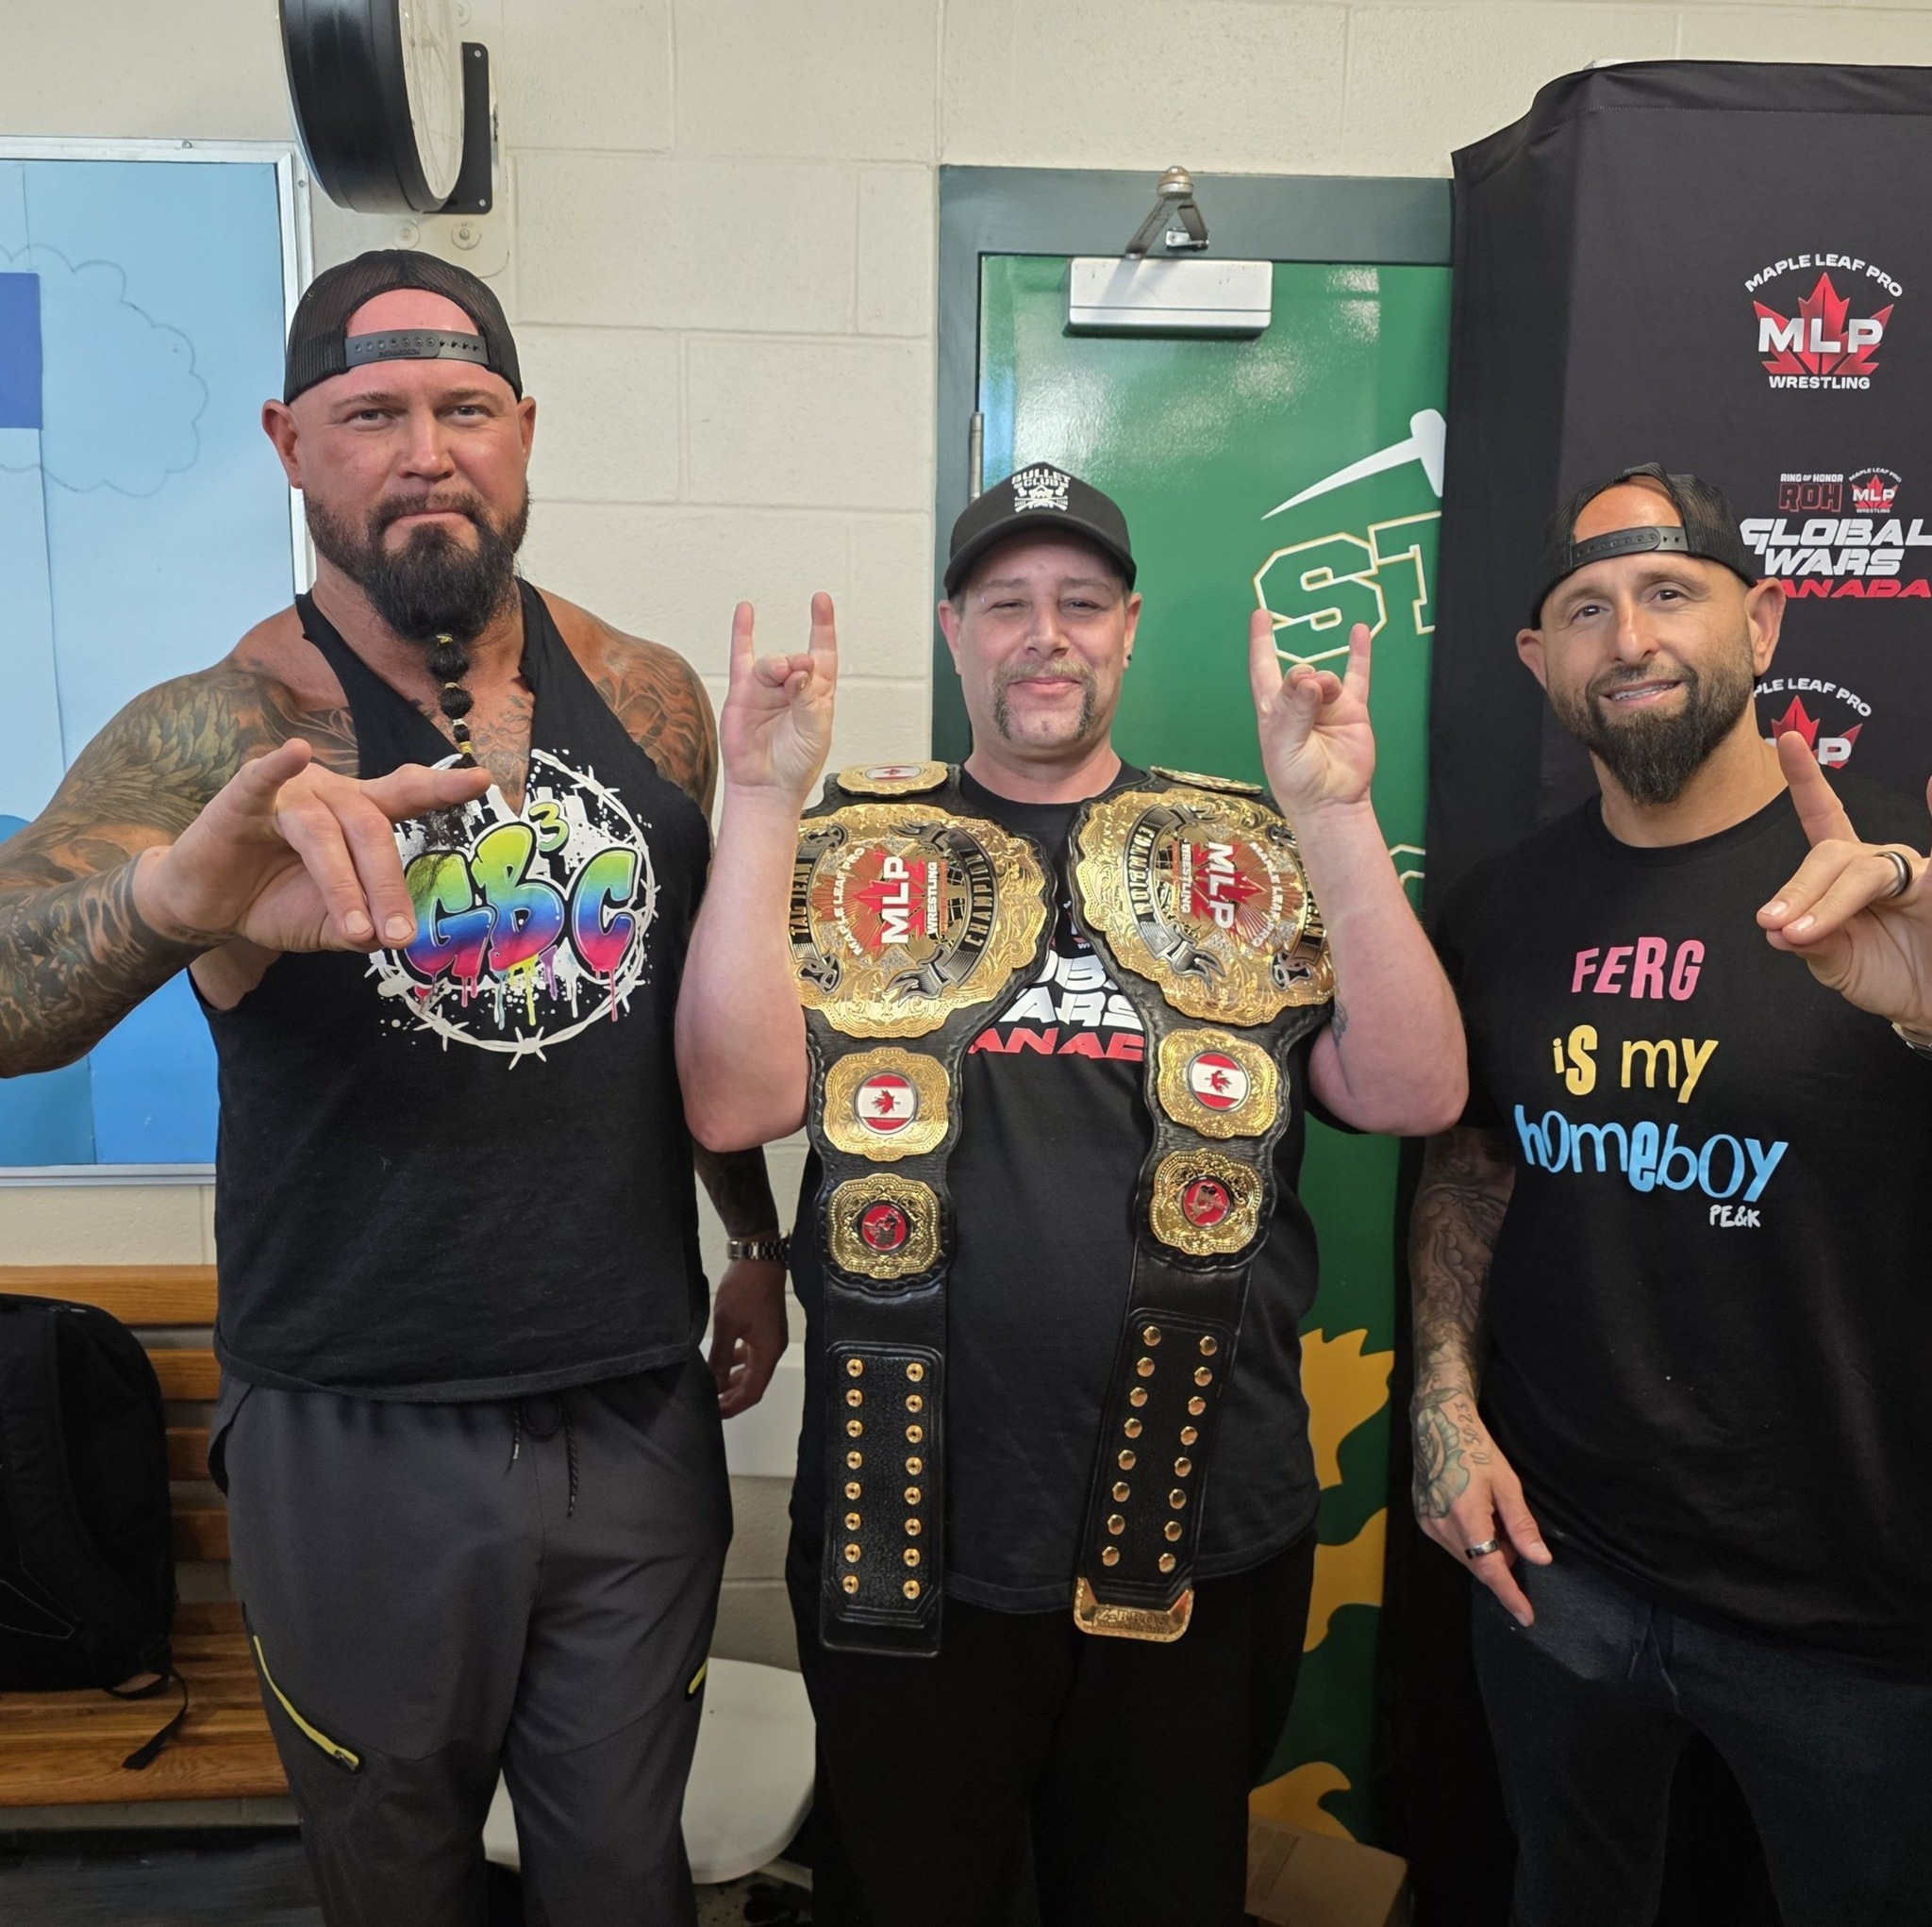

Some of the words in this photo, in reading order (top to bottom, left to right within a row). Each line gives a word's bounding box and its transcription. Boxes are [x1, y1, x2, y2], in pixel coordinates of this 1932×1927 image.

[1745, 254, 1811, 292] MAPLE
[1815, 253, 1866, 272] LEAF
[1865, 265, 1903, 297] PRO
[1757, 317, 1884, 353] MLP
[1769, 375, 1871, 390] WRESTLING
[1011, 469, 1071, 485] BULLET
[1023, 477, 1058, 488] CLUB
[1780, 473, 1802, 482] RING
[1813, 473, 1844, 482] HONOR
[1849, 468, 1872, 482] MAPLE
[1889, 471, 1903, 483] PRO
[1778, 482, 1842, 512] ROH
[1852, 489, 1895, 501] MLP
[1740, 518, 1932, 555] GLOBAL
[1764, 548, 1906, 576] WARS
[1757, 578, 1932, 598] ANADA
[1753, 678, 1784, 698] PLE
[1788, 677, 1837, 694] LEAF
[1836, 687, 1873, 717] PRO
[844, 847, 866, 871] PRO
[833, 871, 847, 905] LEAF
[1180, 841, 1191, 914] WRESTLING
[1208, 841, 1236, 929] MLP
[880, 856, 910, 944] MLP
[926, 861, 938, 935] WRESTLING
[964, 855, 992, 947] CHAMPION
[833, 906, 864, 956] MAPLE
[1572, 937, 1706, 1001] FERG
[998, 986, 1144, 1031] ARS
[1621, 1038, 1720, 1104] my
[1708, 1204, 1761, 1228] PE&K
